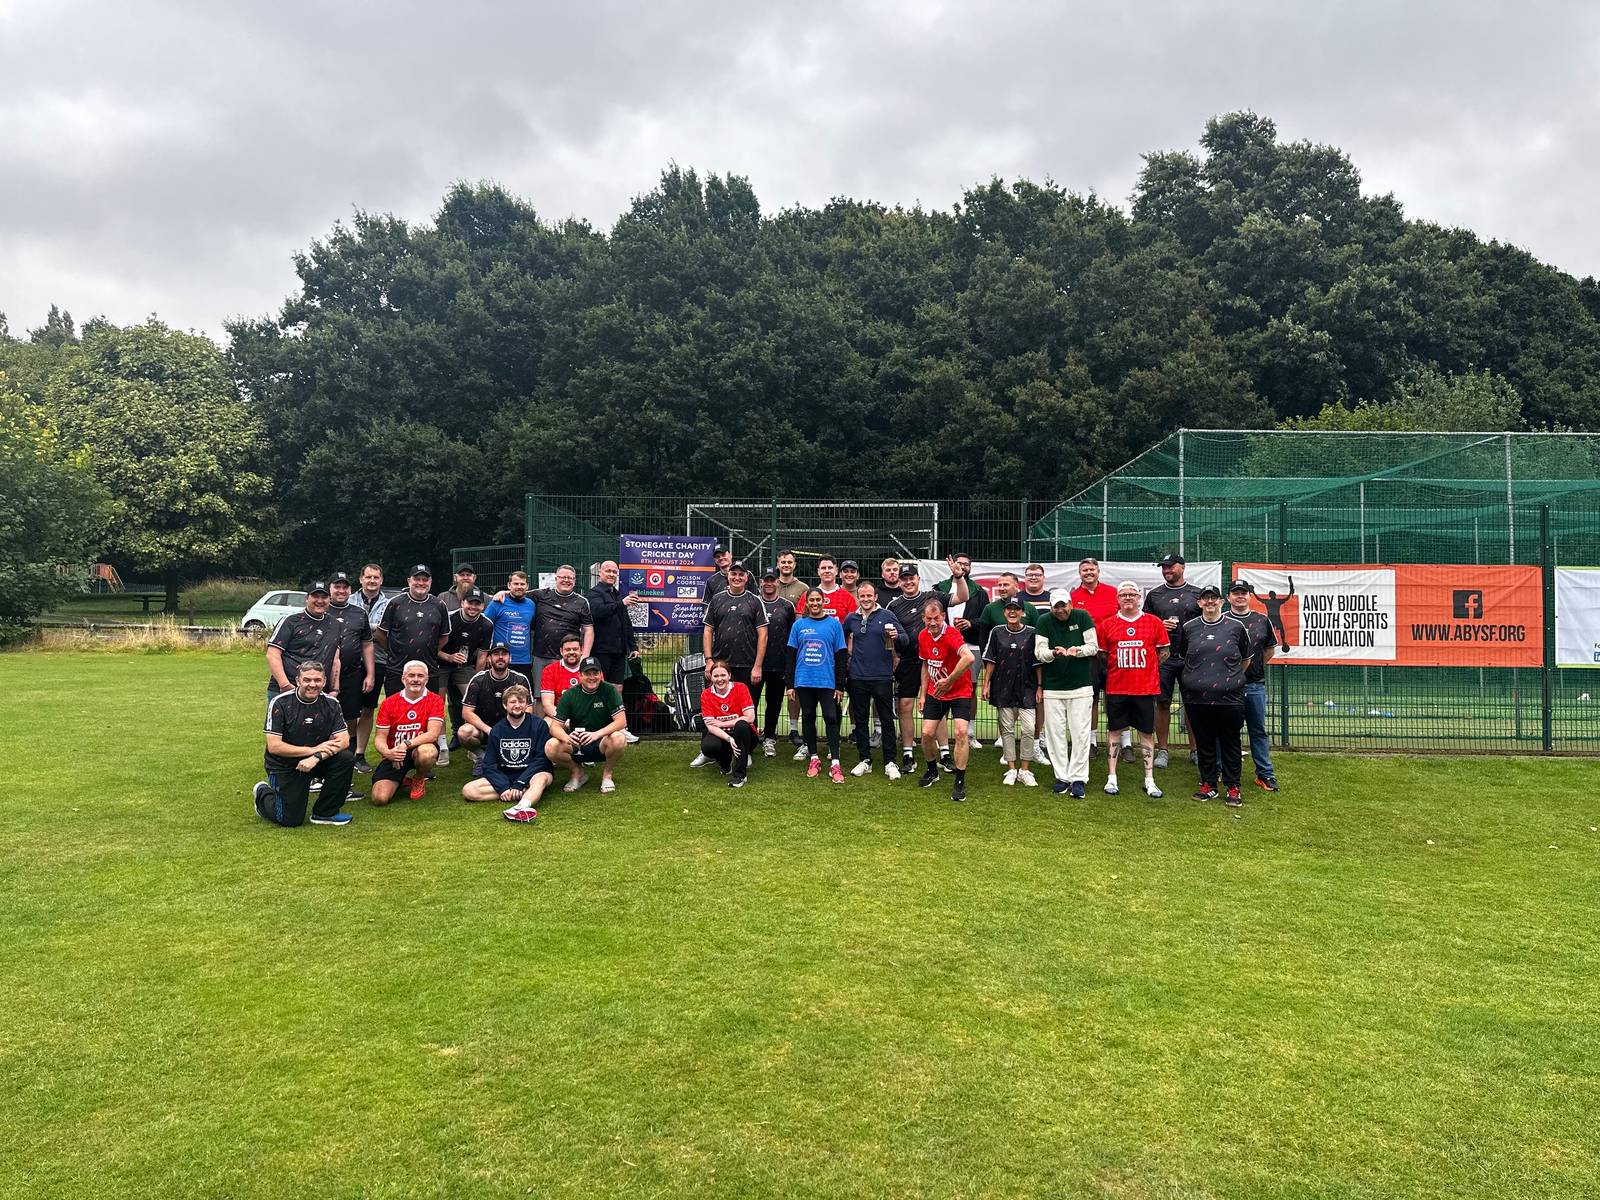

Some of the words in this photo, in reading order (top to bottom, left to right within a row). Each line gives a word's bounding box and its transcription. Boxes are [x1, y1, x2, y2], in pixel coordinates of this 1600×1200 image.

[625, 541, 674, 549] STONEGATE
[674, 604, 689, 612] Scan
[1303, 595, 1334, 611] ANDY
[1337, 595, 1378, 611] BIDDLE
[1303, 613, 1340, 629] YOUTH
[1343, 613, 1388, 629] SPORTS
[1303, 630, 1374, 647] FOUNDATION
[1411, 624, 1525, 641] WWW.ABYSF.ORG
[1117, 648, 1147, 668] HELLS
[502, 740, 530, 748] adidas
